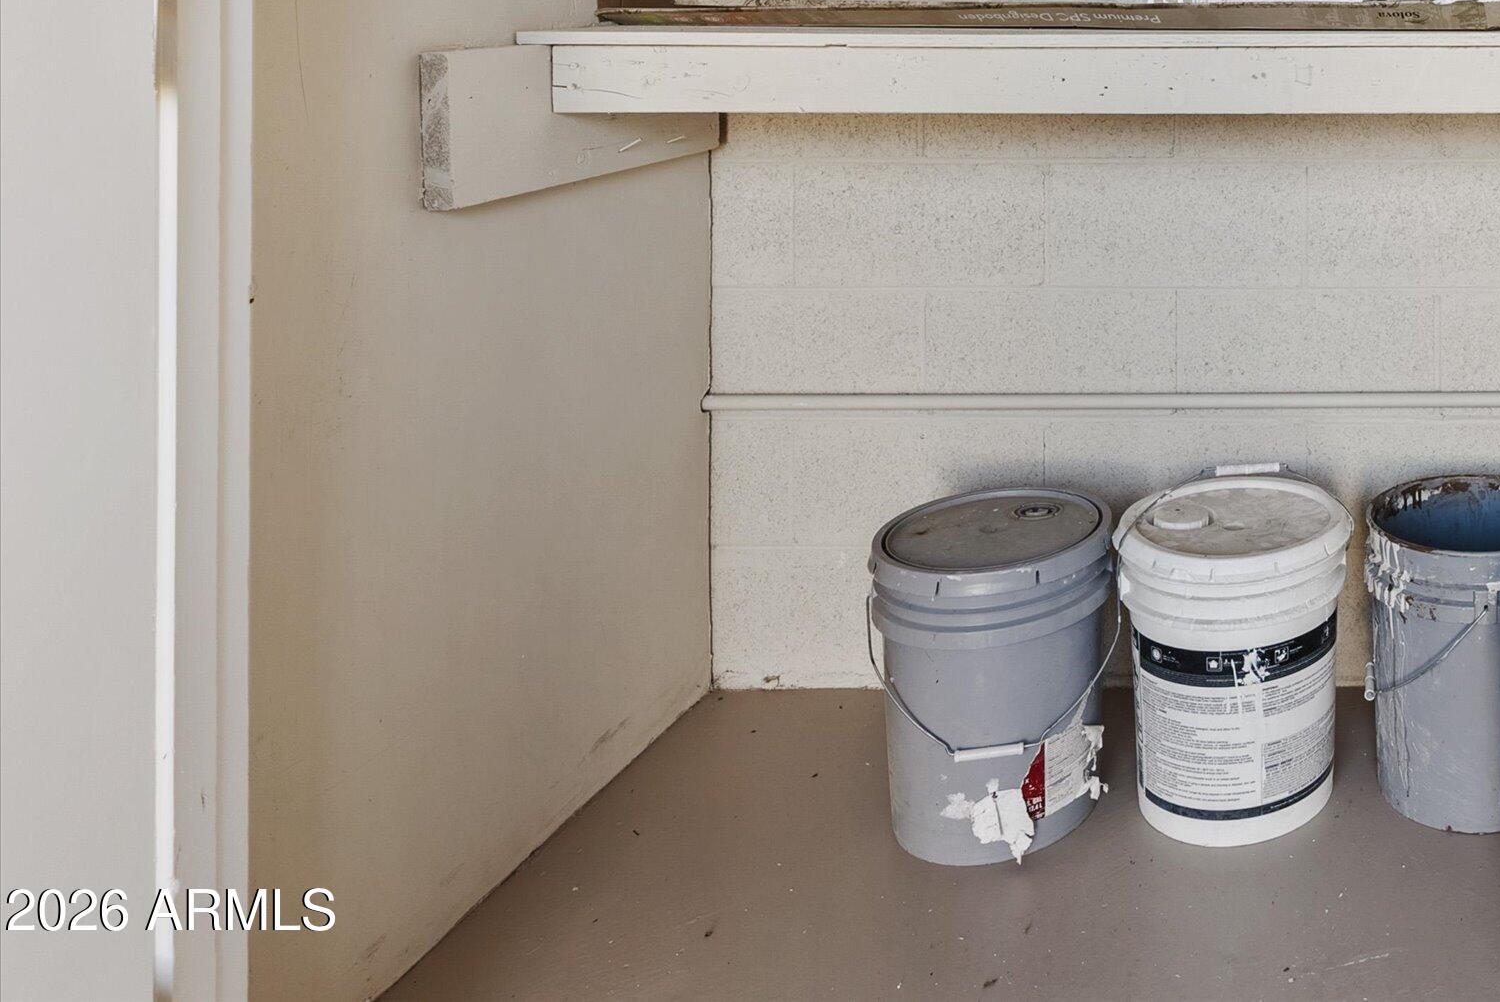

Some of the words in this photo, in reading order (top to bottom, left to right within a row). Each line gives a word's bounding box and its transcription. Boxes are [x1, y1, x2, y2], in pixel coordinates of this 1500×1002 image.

[958, 10, 1053, 22] Designboden
[1057, 12, 1091, 23] SPC
[1093, 13, 1161, 23] Premium
